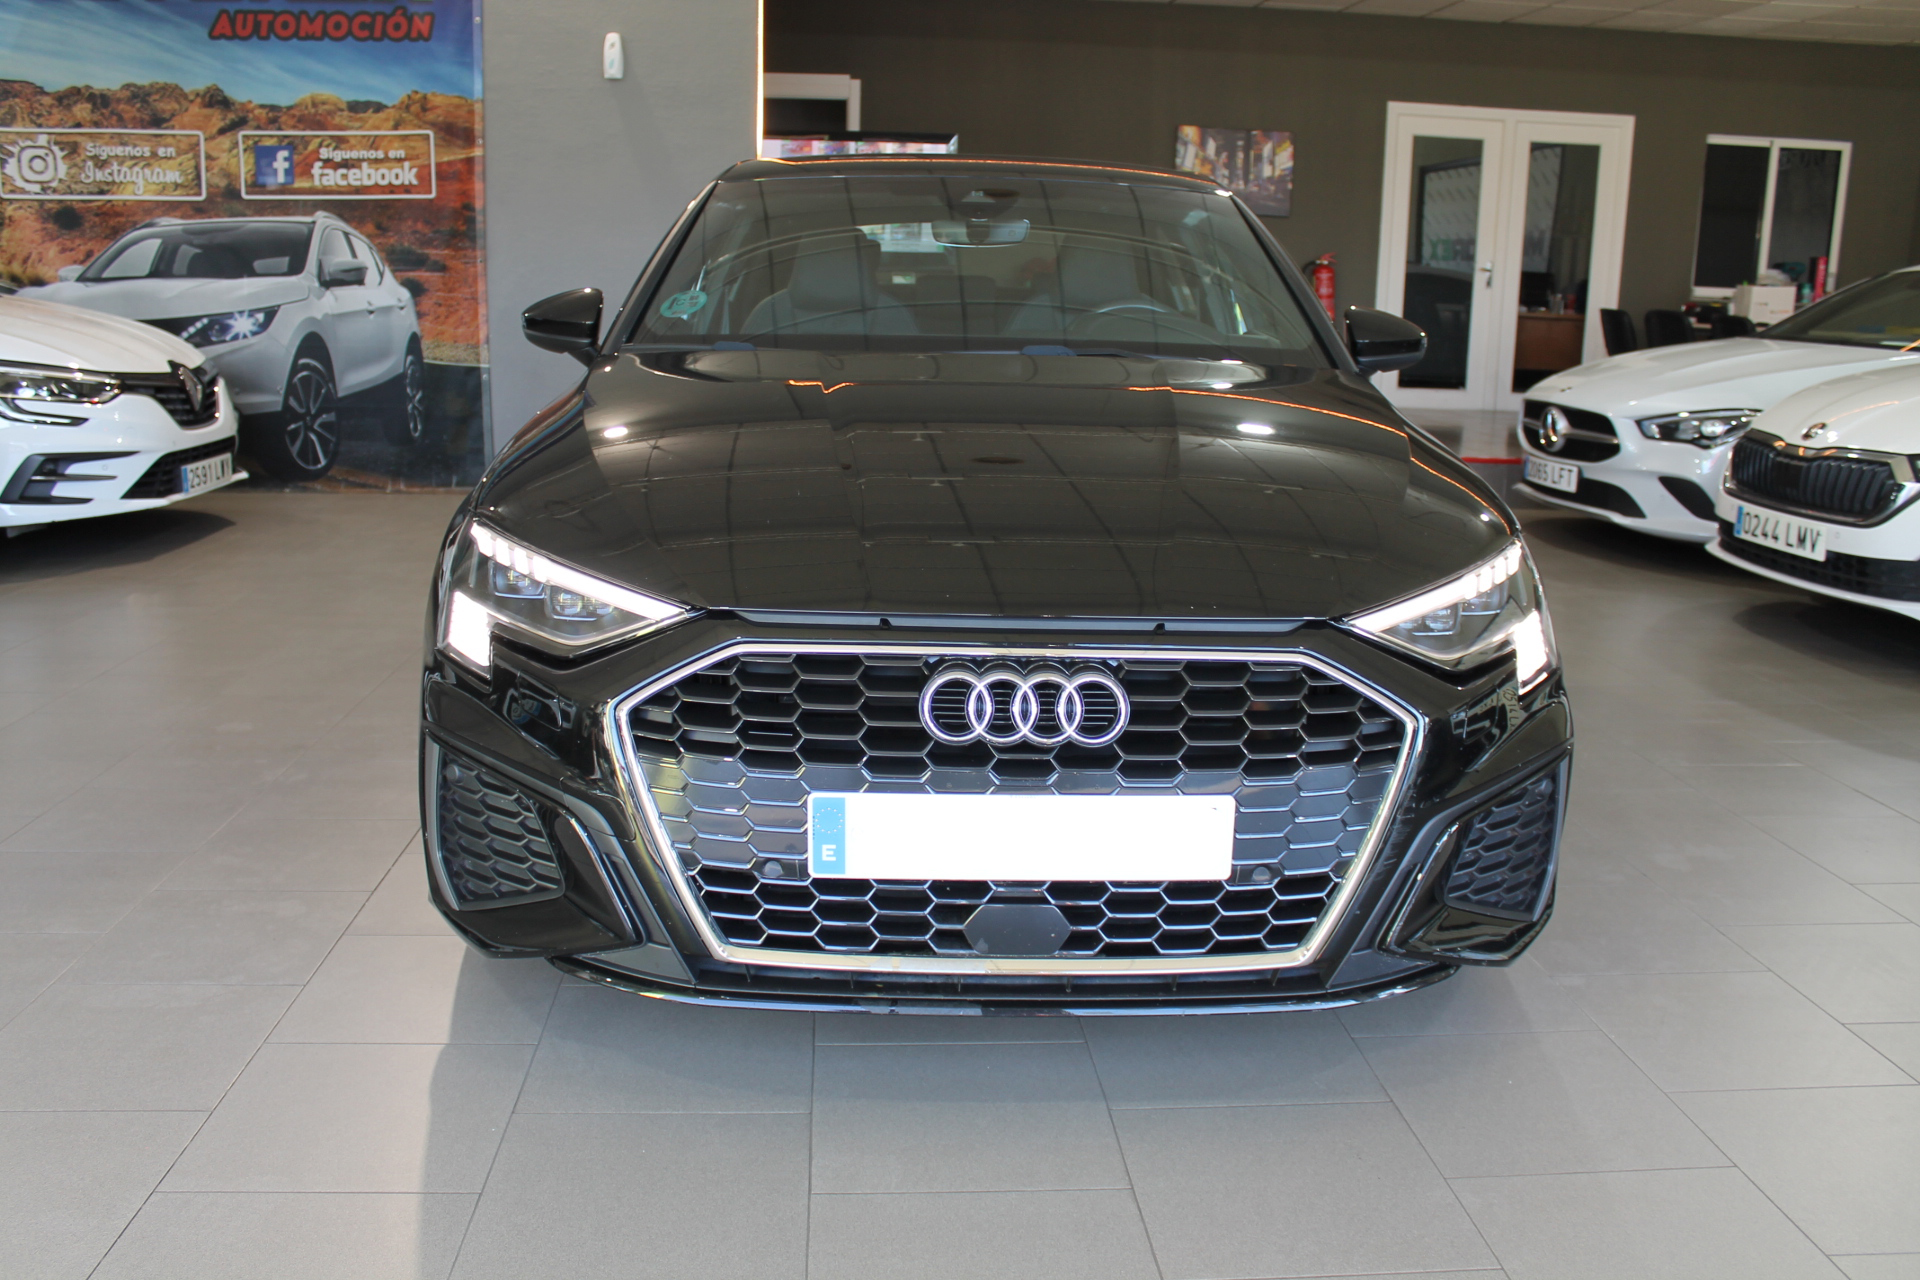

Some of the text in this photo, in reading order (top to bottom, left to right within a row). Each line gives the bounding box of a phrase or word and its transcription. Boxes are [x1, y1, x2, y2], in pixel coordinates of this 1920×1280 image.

[209, 7, 434, 40] AUTOMOCIÓN
[157, 146, 176, 158] en
[388, 149, 405, 159] en
[81, 160, 183, 195] Instagram
[311, 160, 419, 186] facebook
[1743, 511, 1822, 553] 0244 LMV
[821, 844, 837, 862] E
